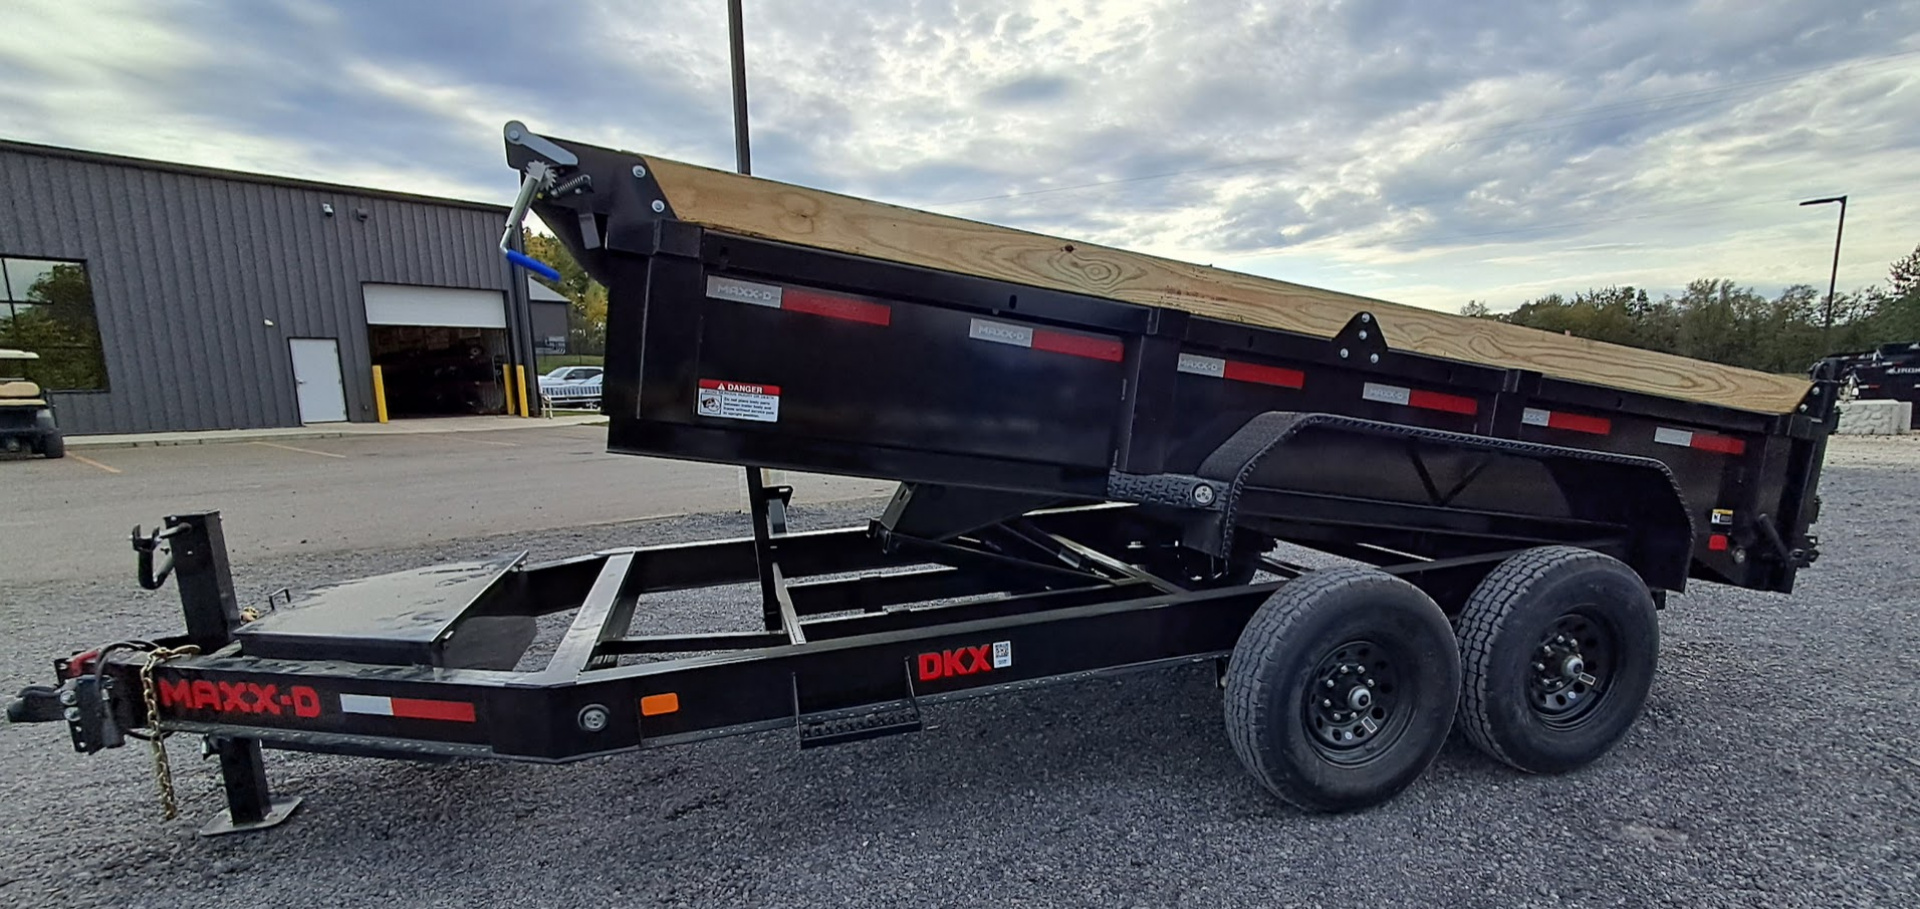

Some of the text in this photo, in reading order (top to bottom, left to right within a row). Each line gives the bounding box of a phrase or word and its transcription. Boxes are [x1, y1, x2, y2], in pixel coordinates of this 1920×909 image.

[717, 283, 772, 301] MAXX-D
[978, 325, 1025, 341] MAXX-D
[1180, 358, 1218, 371] MAXX-D
[727, 383, 763, 394] DANGER
[918, 643, 993, 681] DKX
[158, 677, 321, 718] MAXX-D
